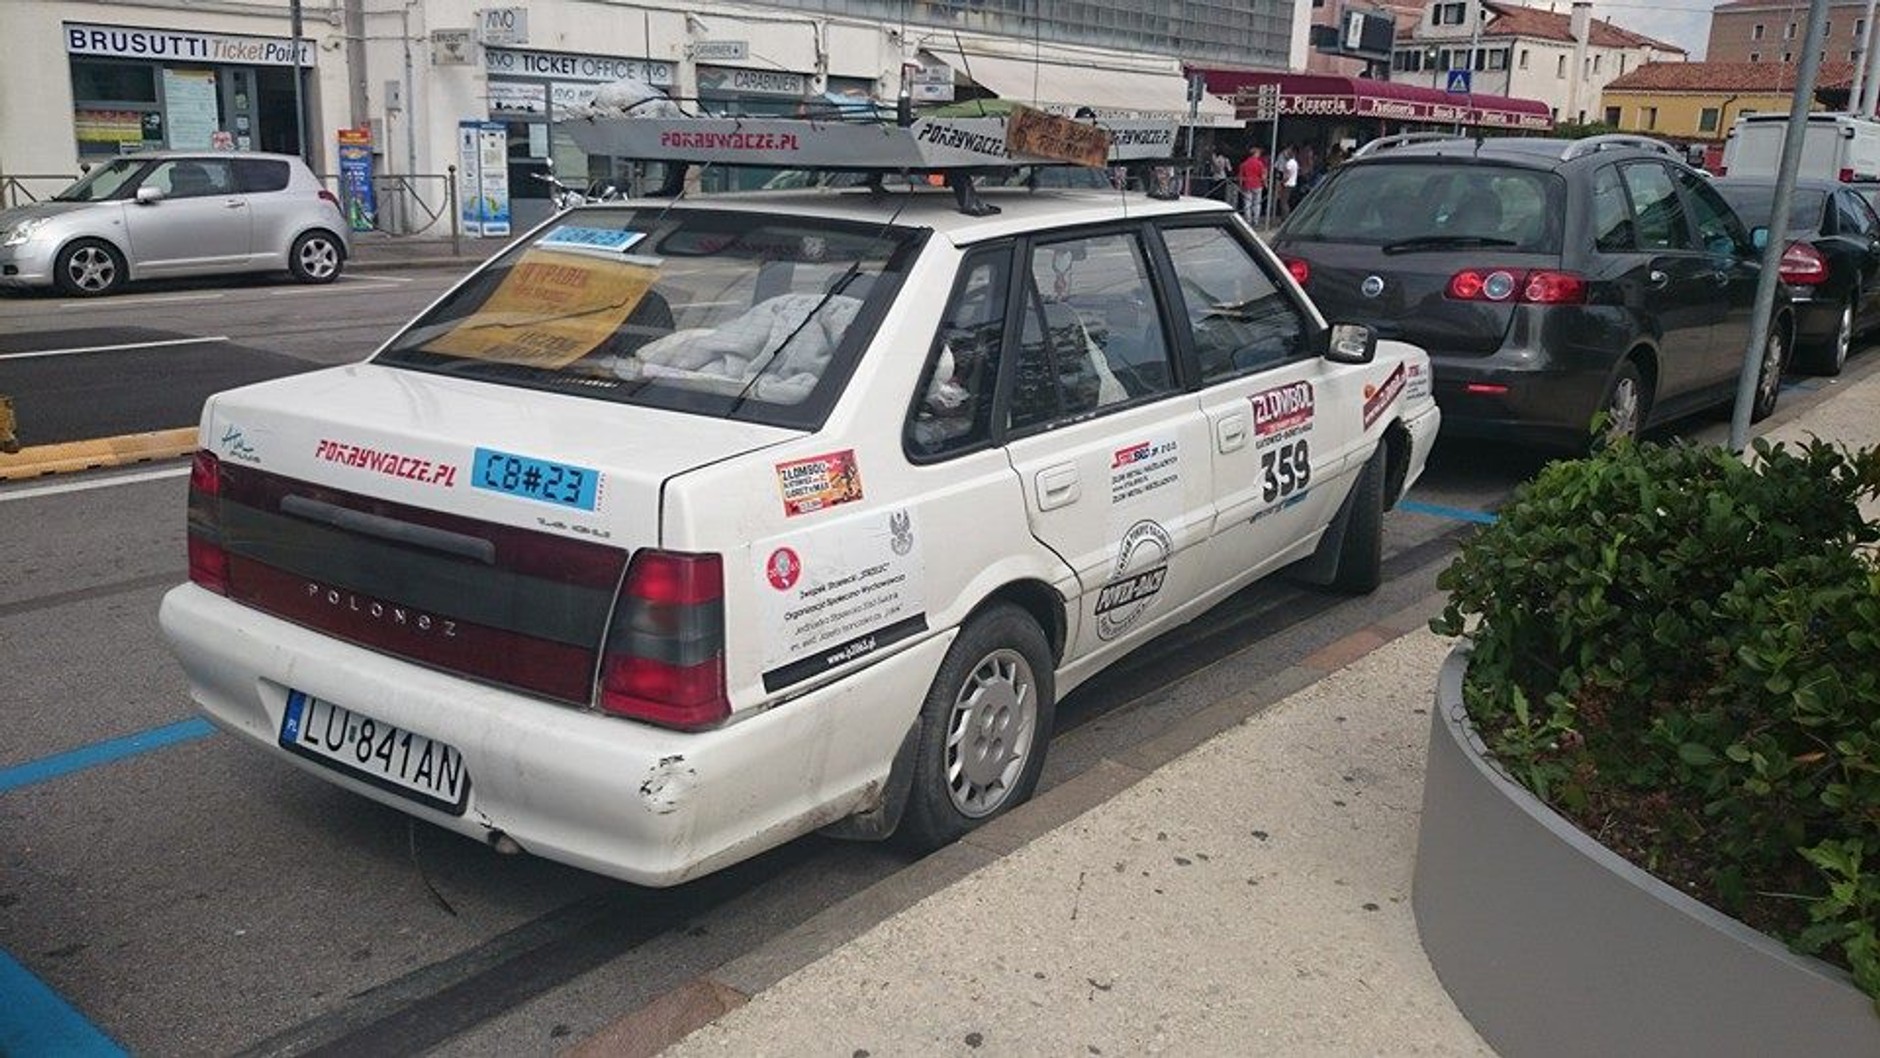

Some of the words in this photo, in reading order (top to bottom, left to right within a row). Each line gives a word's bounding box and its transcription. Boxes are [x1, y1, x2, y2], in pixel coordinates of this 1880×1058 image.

[69, 28, 208, 59] BRUSUTTI
[522, 54, 577, 75] TICKET
[581, 59, 636, 80] OFFICE
[733, 71, 800, 93] CARABINIERI
[1295, 96, 1347, 113] Pizzeria
[661, 131, 800, 151] POKRYWACZE.PL
[315, 439, 458, 487] POKRYWACZE.PL
[1261, 439, 1312, 503] 359
[308, 583, 457, 637] POLONEZ
[287, 718, 298, 732] PL
[304, 699, 350, 751] LU
[356, 718, 462, 797] 841AN
